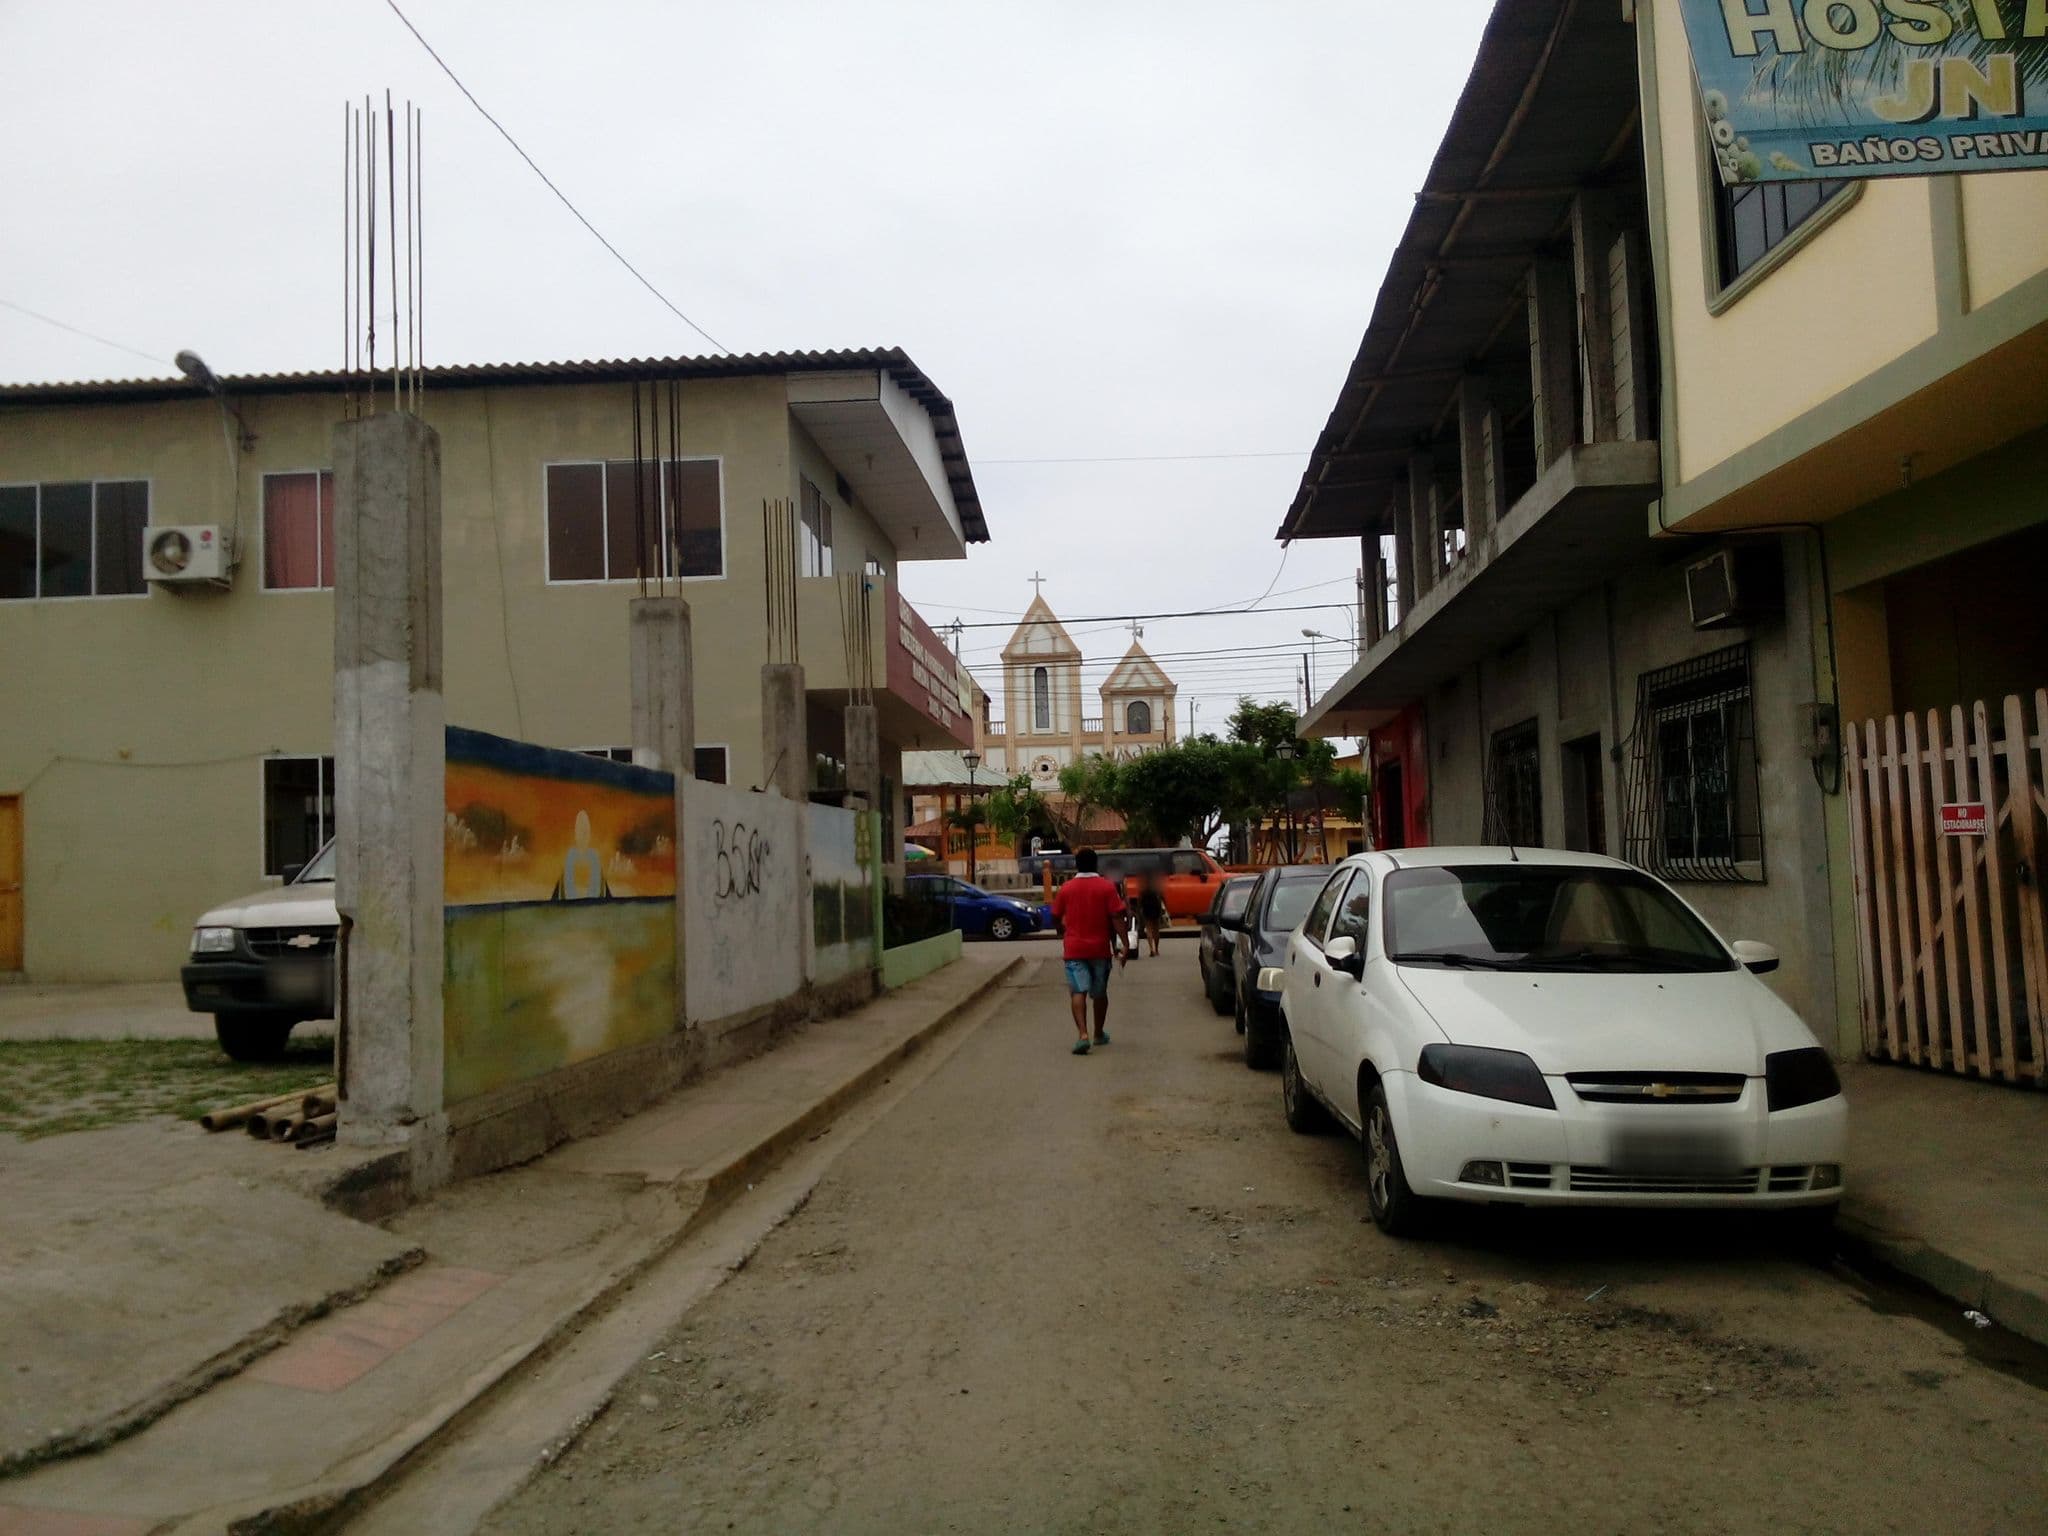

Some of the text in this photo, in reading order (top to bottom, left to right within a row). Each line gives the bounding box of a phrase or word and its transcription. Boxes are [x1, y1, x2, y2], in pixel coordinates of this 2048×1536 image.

[1871, 53, 2021, 123] JN
[1810, 135, 1943, 166] BAÑOS
[1957, 807, 1967, 818] NO
[1943, 819, 1984, 829] ESTACIONARSE
